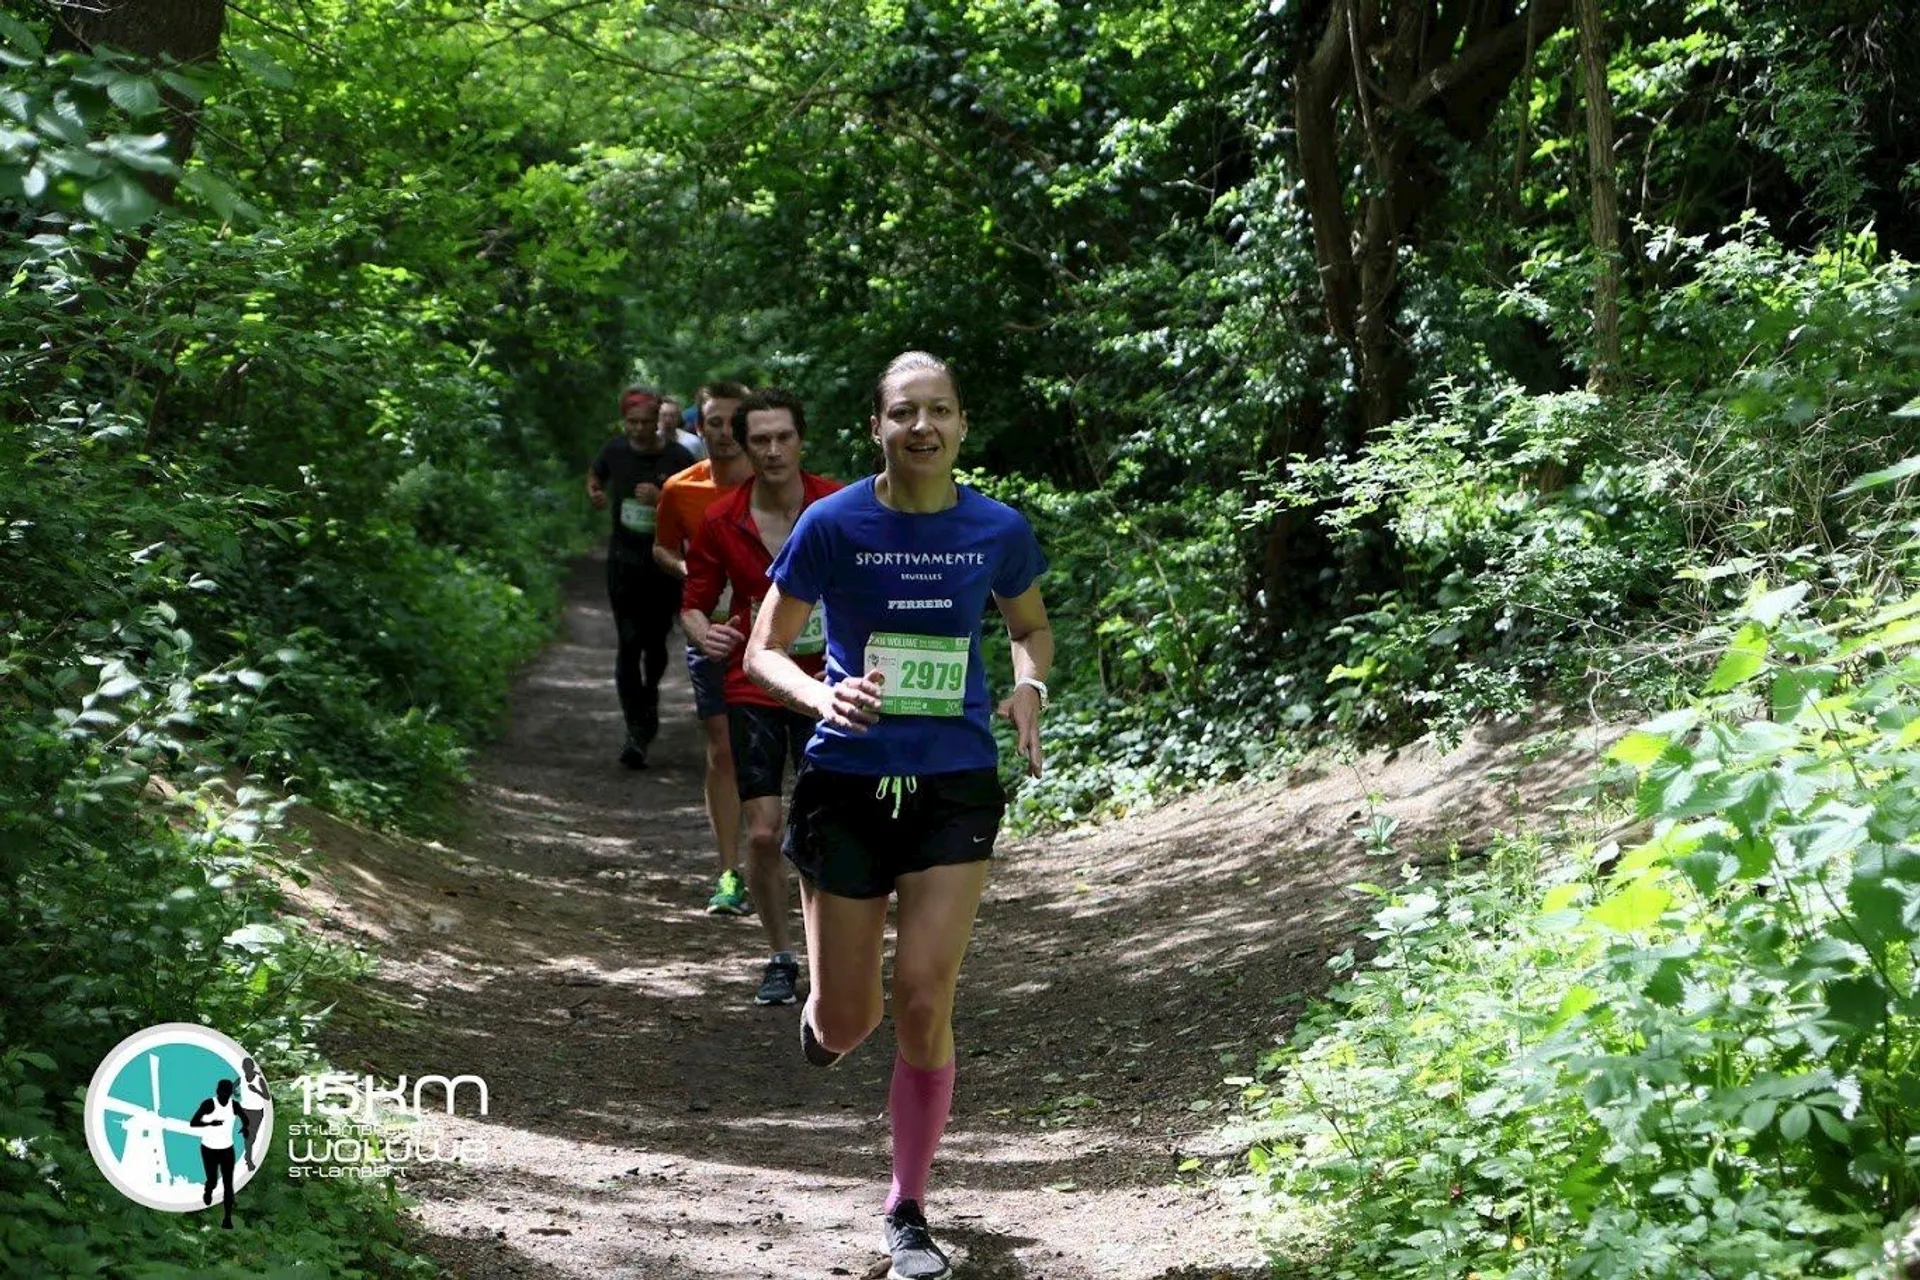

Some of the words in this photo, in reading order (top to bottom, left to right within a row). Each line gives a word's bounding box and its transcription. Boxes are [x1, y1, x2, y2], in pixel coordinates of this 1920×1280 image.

[855, 551, 985, 566] SPORTIVAMENTE
[887, 598, 953, 610] FERRERO
[900, 660, 963, 691] 2979
